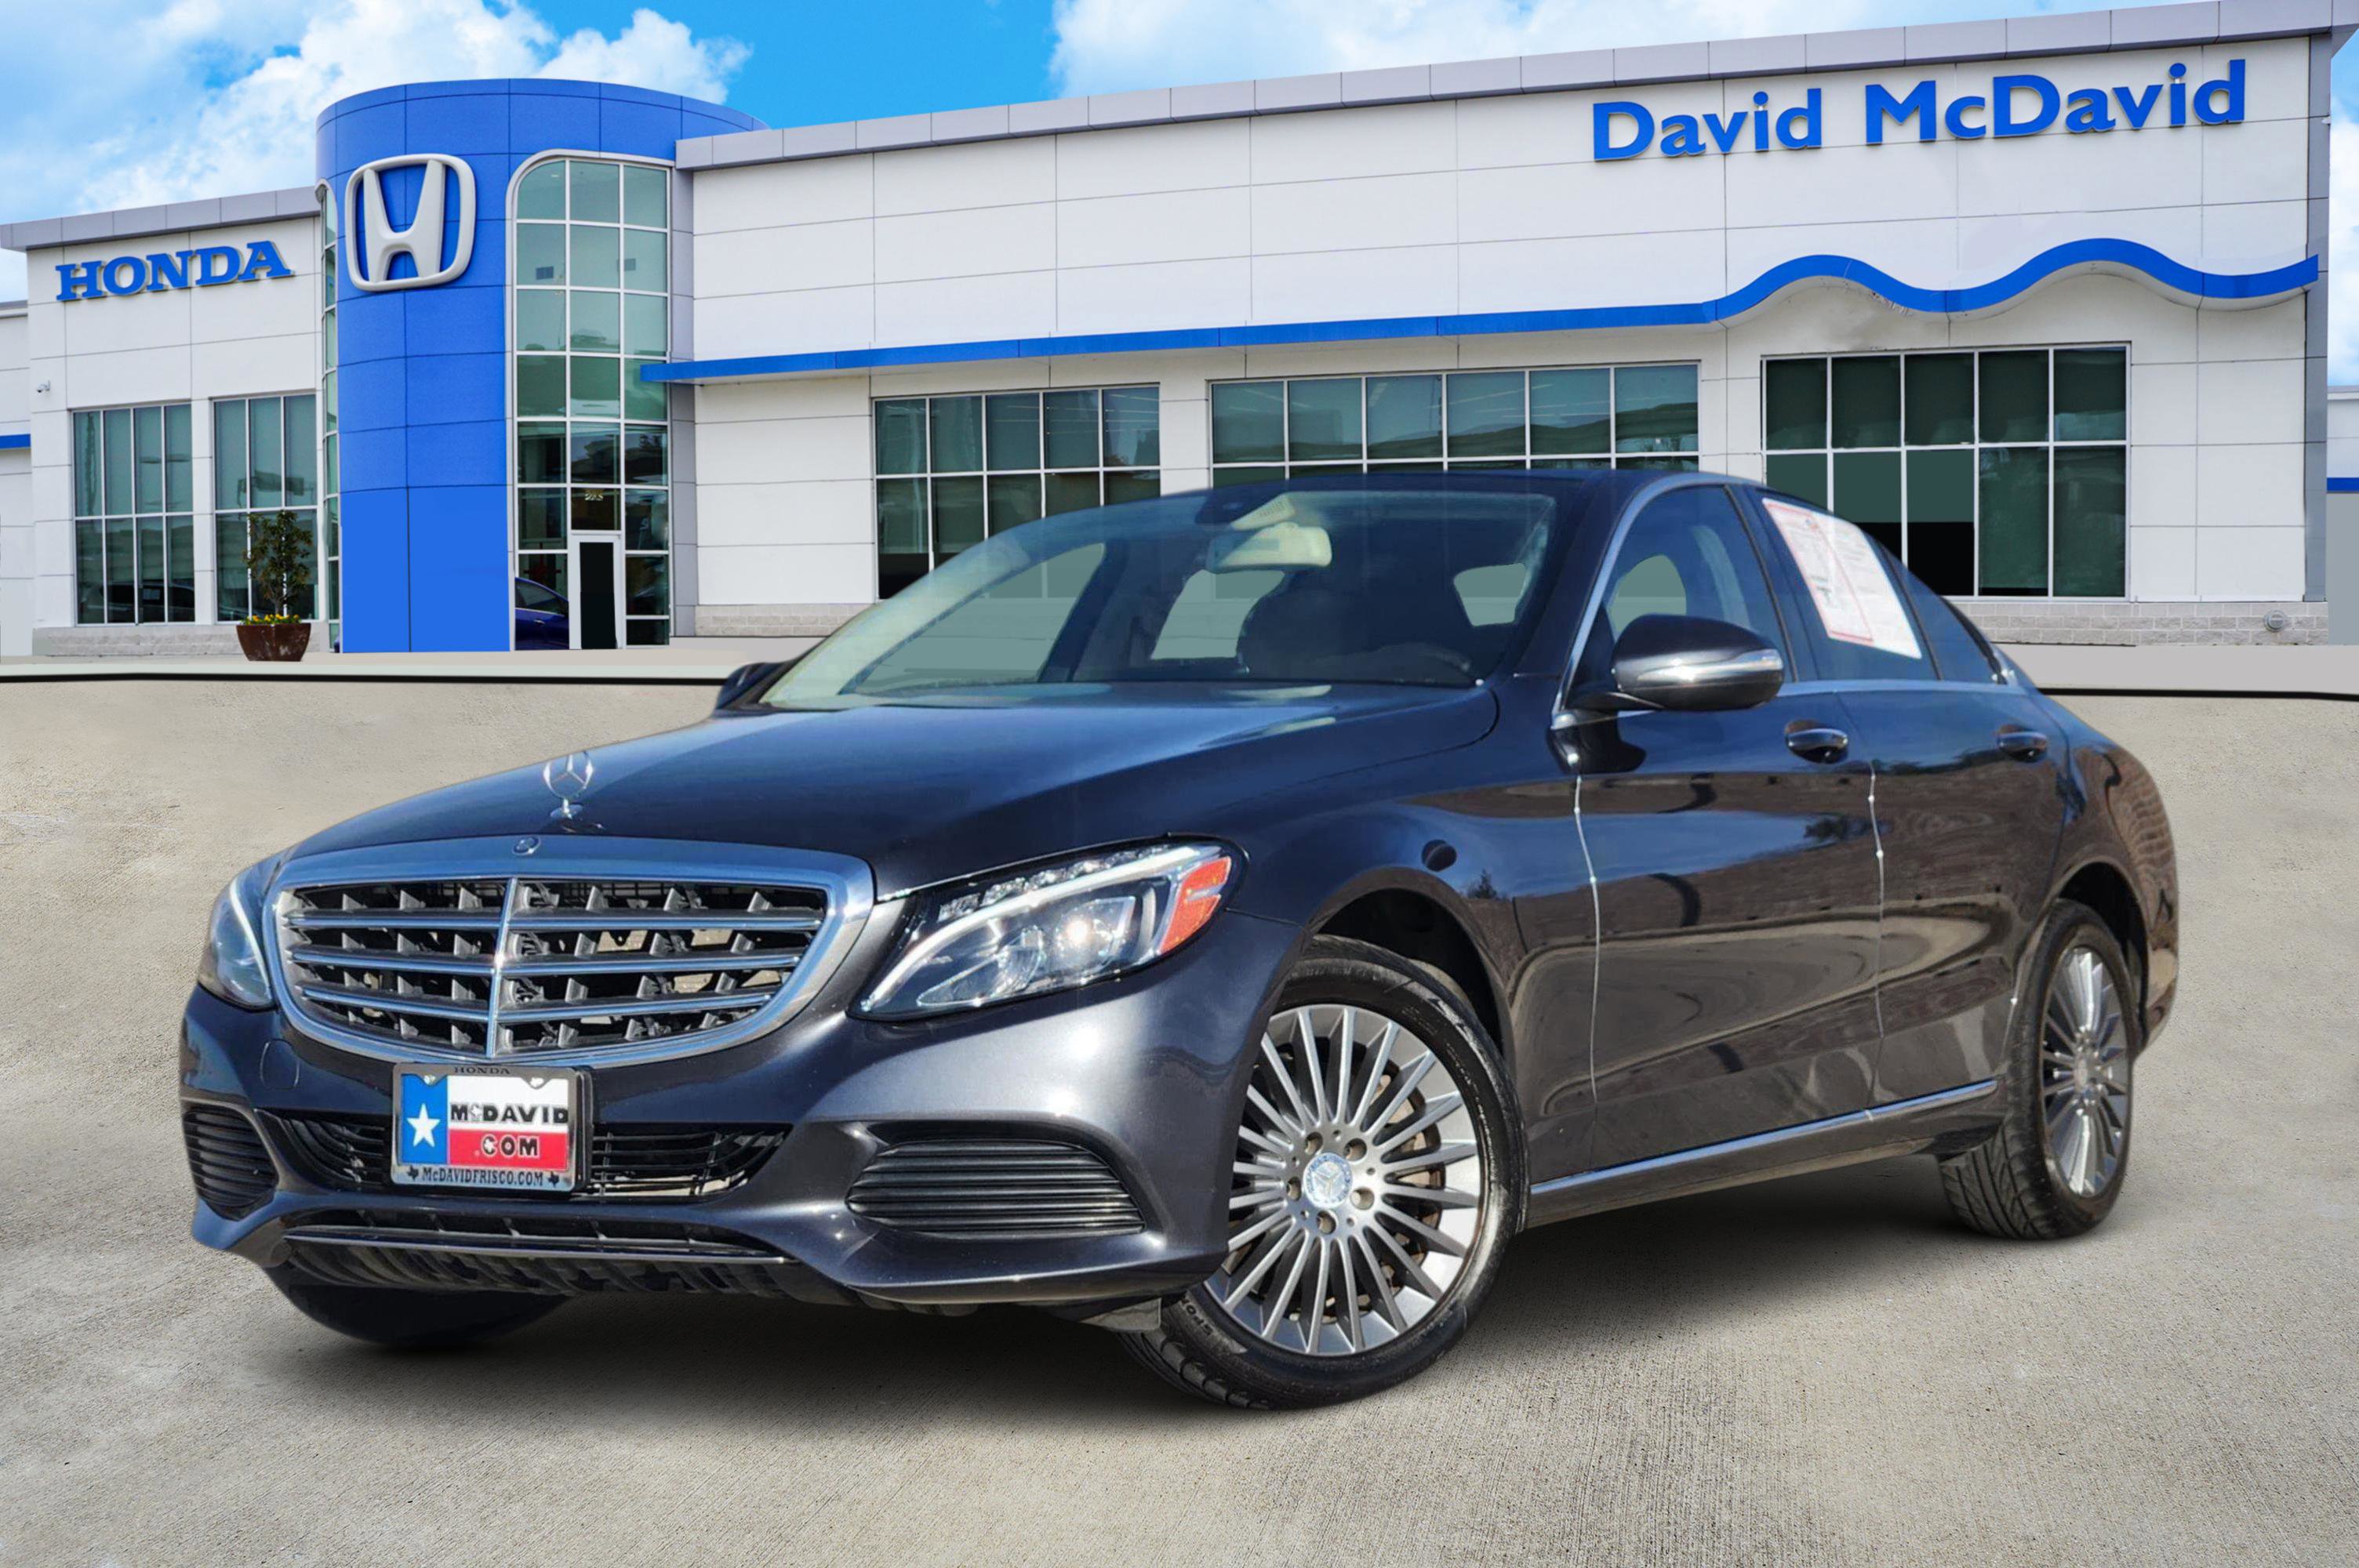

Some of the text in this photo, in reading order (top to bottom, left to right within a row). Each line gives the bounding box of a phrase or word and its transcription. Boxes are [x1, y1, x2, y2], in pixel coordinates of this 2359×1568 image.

[1594, 59, 2245, 161] David McDavid
[56, 241, 291, 301] HONDA
[454, 1066, 511, 1075] HONDA
[422, 1167, 543, 1186] McDAVIDFRISCO.COM
